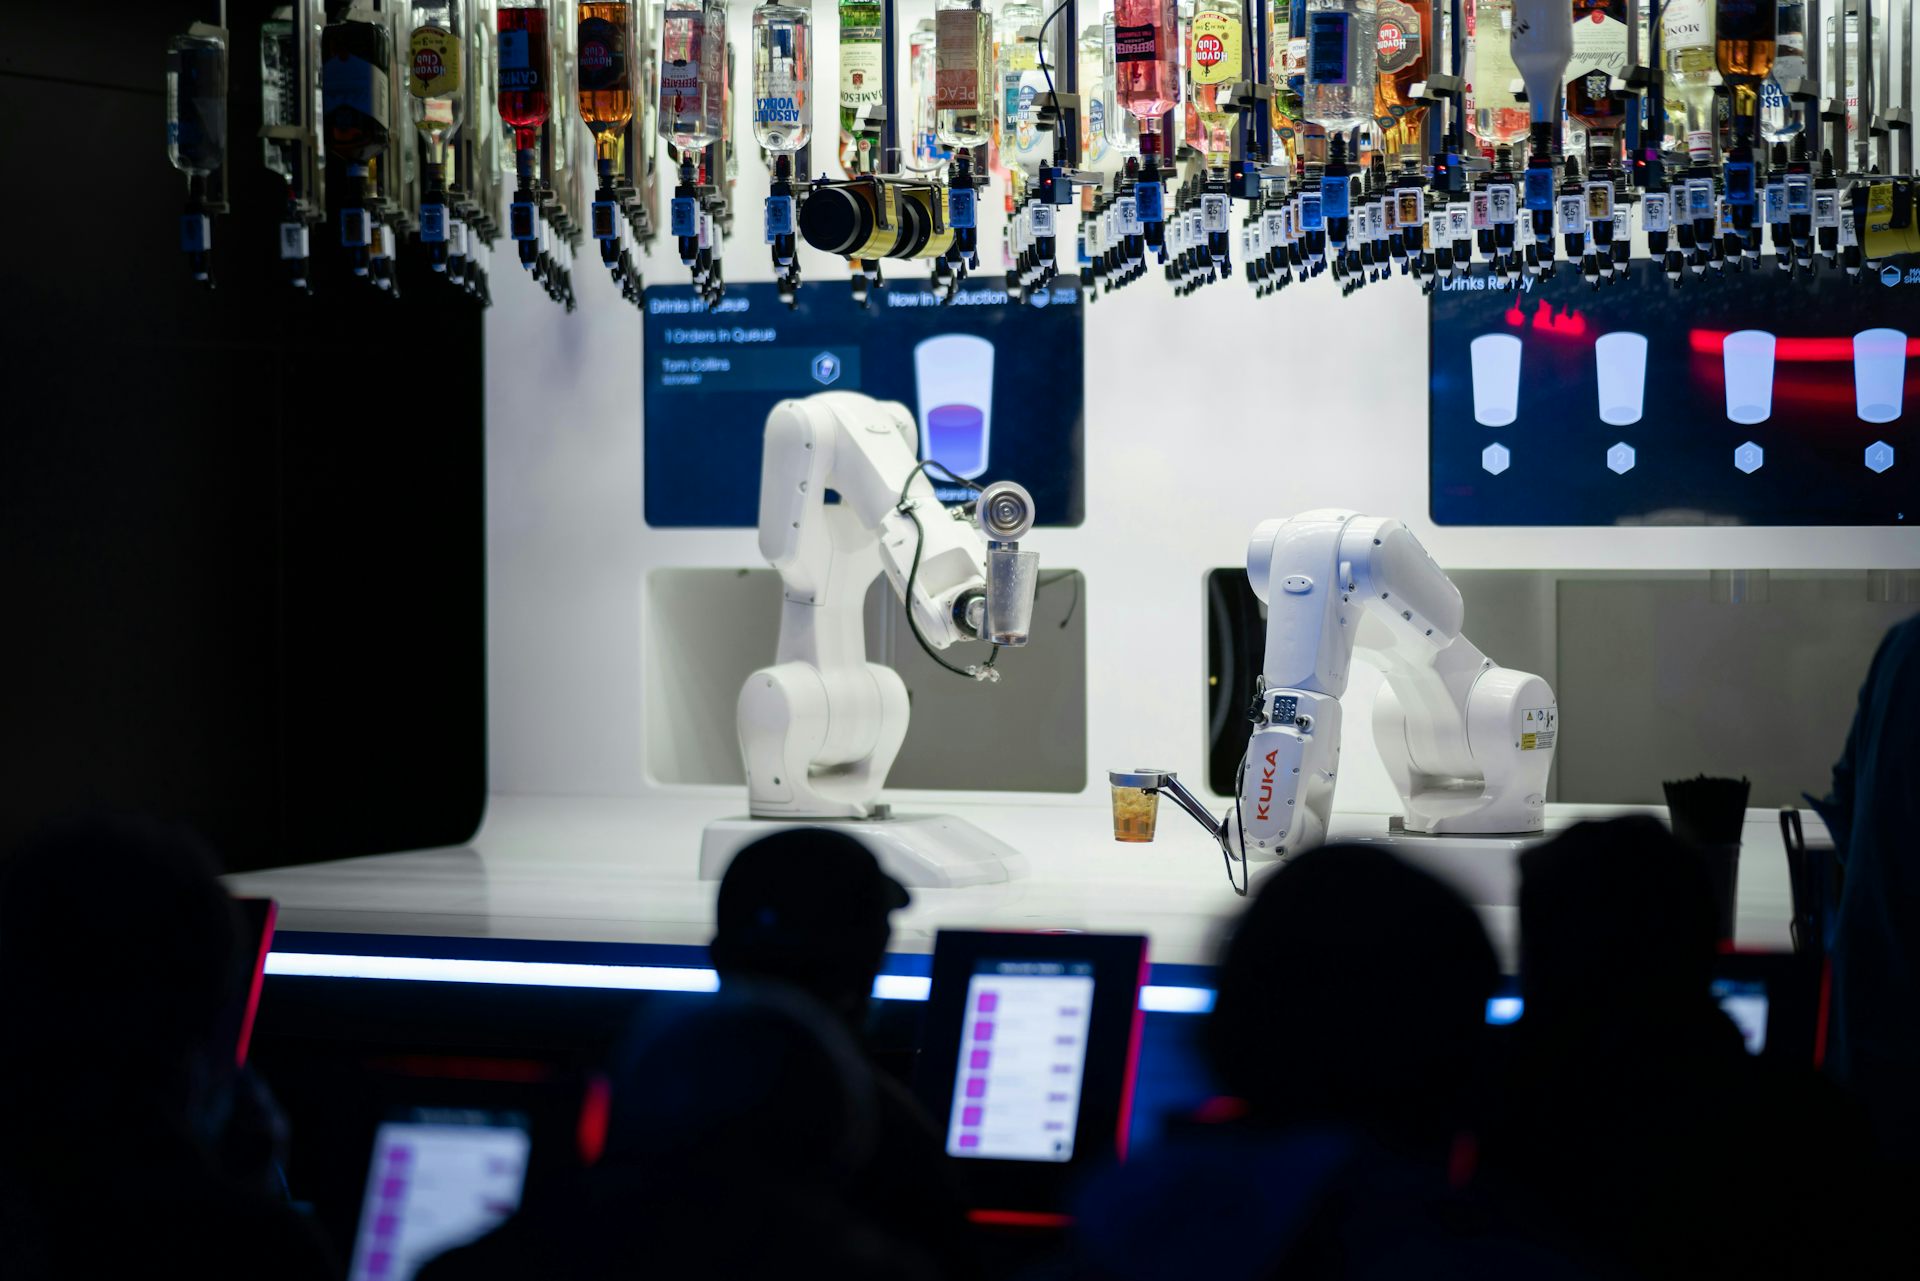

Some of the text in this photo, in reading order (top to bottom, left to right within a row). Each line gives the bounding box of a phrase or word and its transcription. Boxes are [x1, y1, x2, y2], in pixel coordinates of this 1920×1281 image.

[1380, 29, 1398, 39] Club
[1116, 40, 1155, 53] BEEFEATER
[1198, 40, 1220, 49] Club
[585, 47, 606, 57] Club
[416, 54, 438, 64] Club
[500, 71, 538, 84] CAMPA
[662, 76, 698, 88] BEEFEATER
[757, 98, 795, 110] VODKA
[754, 110, 800, 122] ABSOLUT
[1871, 223, 1889, 232] SIC
[650, 297, 690, 314] Drinks
[887, 292, 920, 307] Now
[920, 291, 934, 306] in
[673, 328, 717, 343] Orders
[718, 328, 731, 342] in
[732, 327, 776, 343] Queue
[662, 357, 731, 372] Tom Collins
[1616, 452, 1626, 465] 2
[1744, 450, 1754, 463] 3
[1874, 450, 1885, 463] 4
[1256, 748, 1279, 820] KUKA
